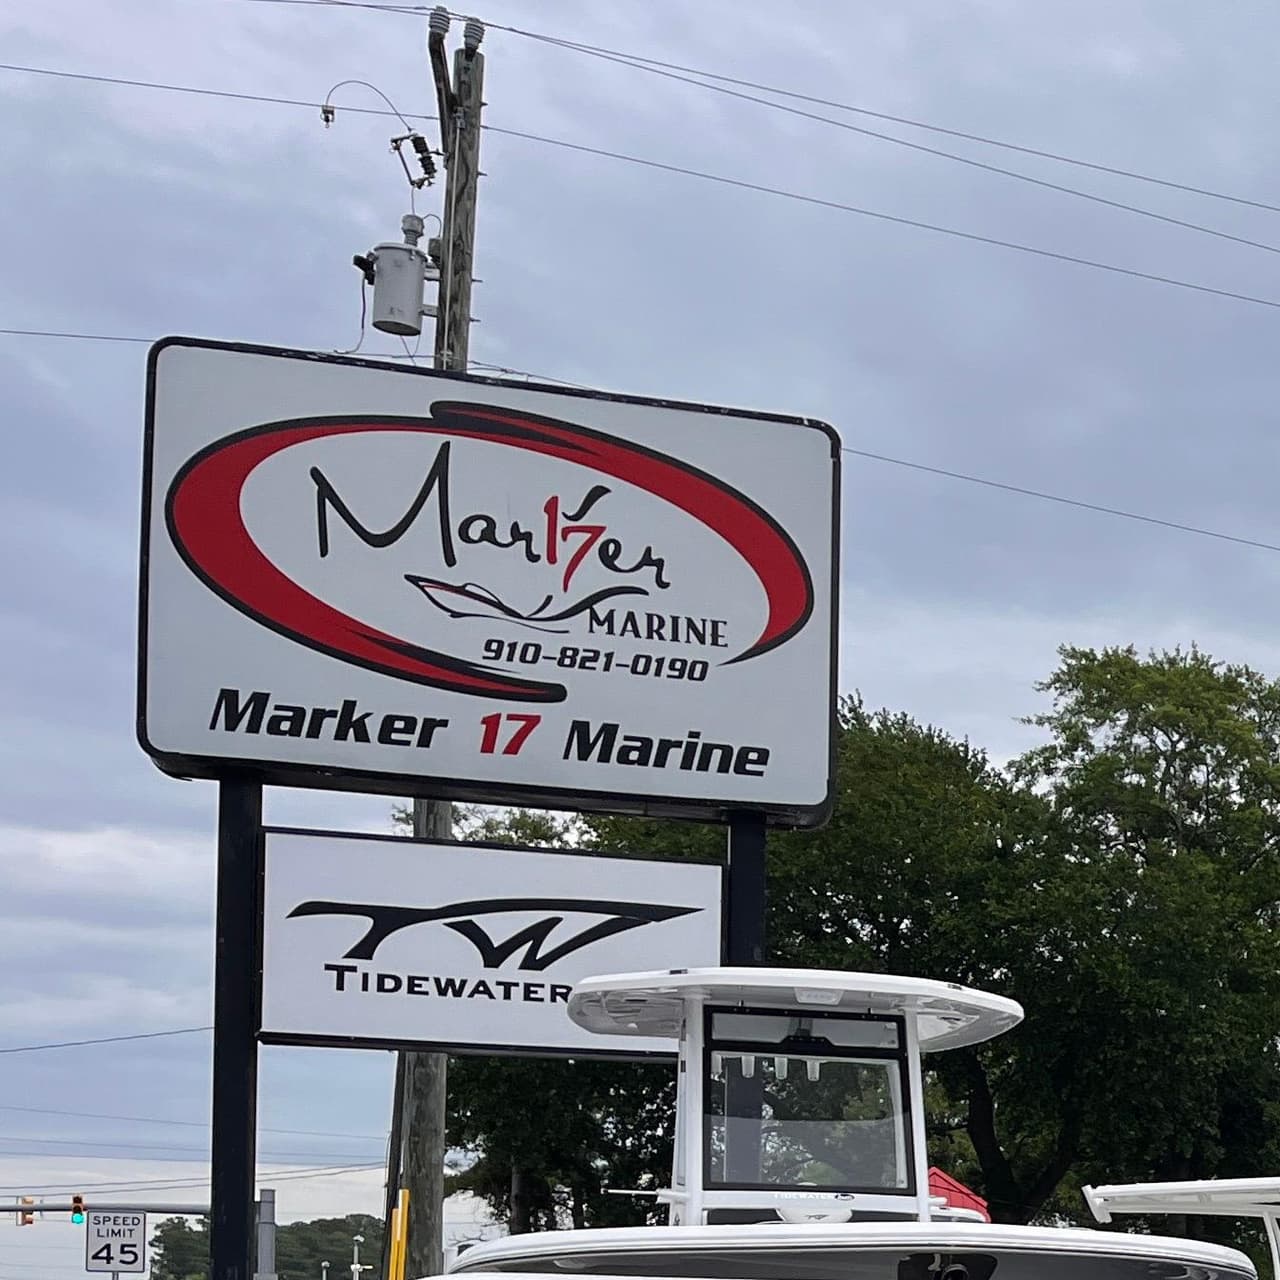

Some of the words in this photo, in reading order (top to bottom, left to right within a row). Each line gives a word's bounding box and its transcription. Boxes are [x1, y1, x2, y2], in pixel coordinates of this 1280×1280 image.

[587, 606, 729, 648] MARINE
[482, 638, 710, 682] 910-821-0190
[209, 688, 449, 749] Marker
[479, 712, 541, 756] 17
[562, 719, 770, 777] Marine
[92, 1215, 141, 1226] SPEED
[97, 1228, 135, 1239] LIMIT
[91, 1243, 139, 1265] 45
